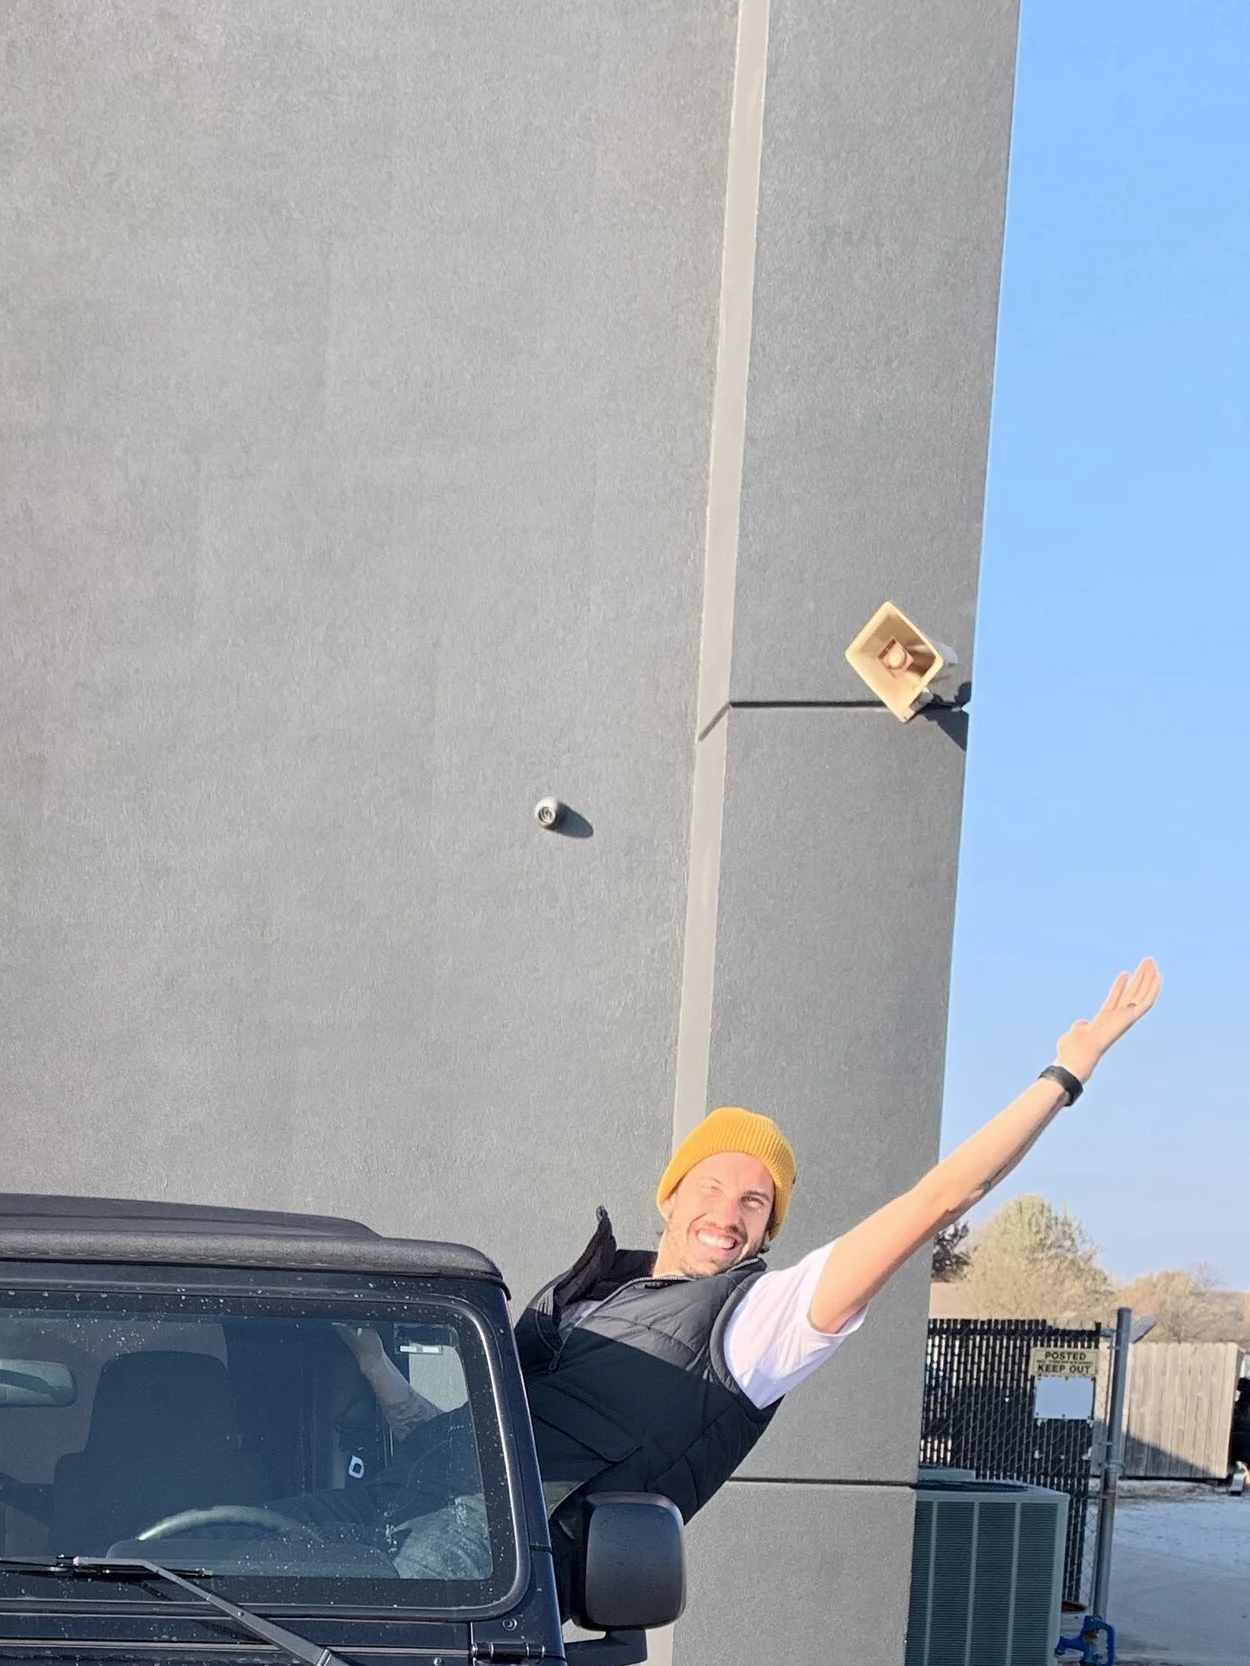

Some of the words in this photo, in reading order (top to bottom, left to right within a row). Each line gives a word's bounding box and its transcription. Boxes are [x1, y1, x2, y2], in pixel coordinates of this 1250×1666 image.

[1045, 1351, 1086, 1361] POSTED
[1038, 1364, 1065, 1372] KEEP
[1069, 1364, 1091, 1374] OUT
